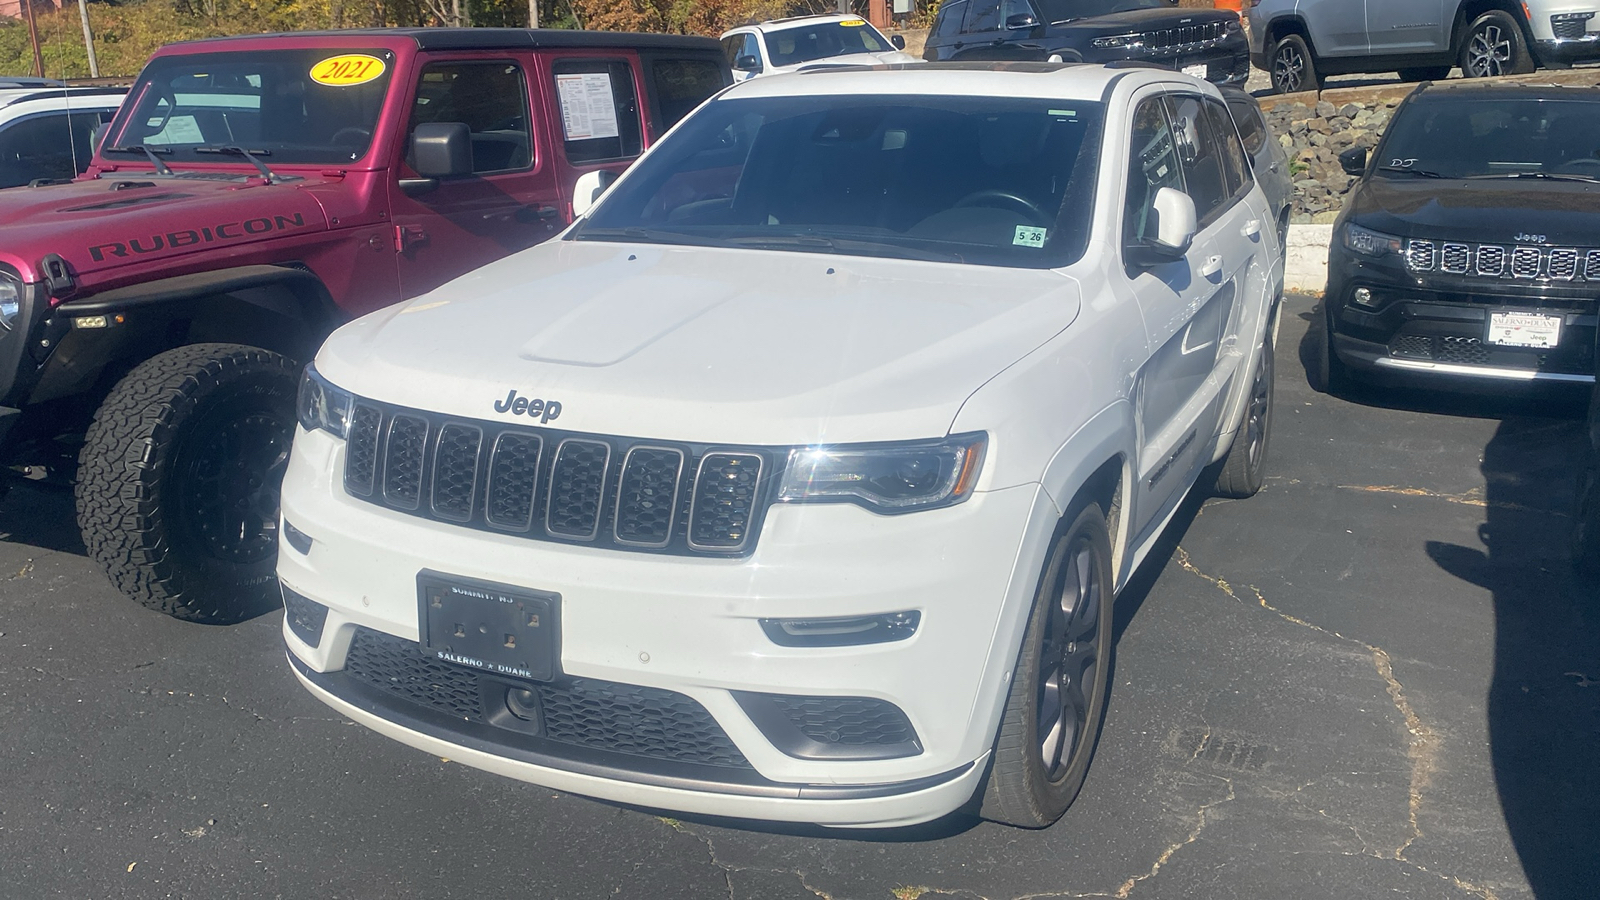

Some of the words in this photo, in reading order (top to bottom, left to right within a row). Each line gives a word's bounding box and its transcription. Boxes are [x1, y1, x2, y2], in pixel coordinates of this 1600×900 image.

[320, 60, 374, 79] 2021
[88, 212, 305, 262] RUBICON
[1019, 231, 1025, 240] 5
[1030, 232, 1041, 241] 26
[1513, 232, 1546, 243] Jeep
[1493, 318, 1526, 326] SALERNO
[1530, 320, 1557, 328] DUANE
[494, 389, 562, 424] Jeep
[437, 651, 483, 667] SALERNO
[498, 664, 532, 678] DUANE
